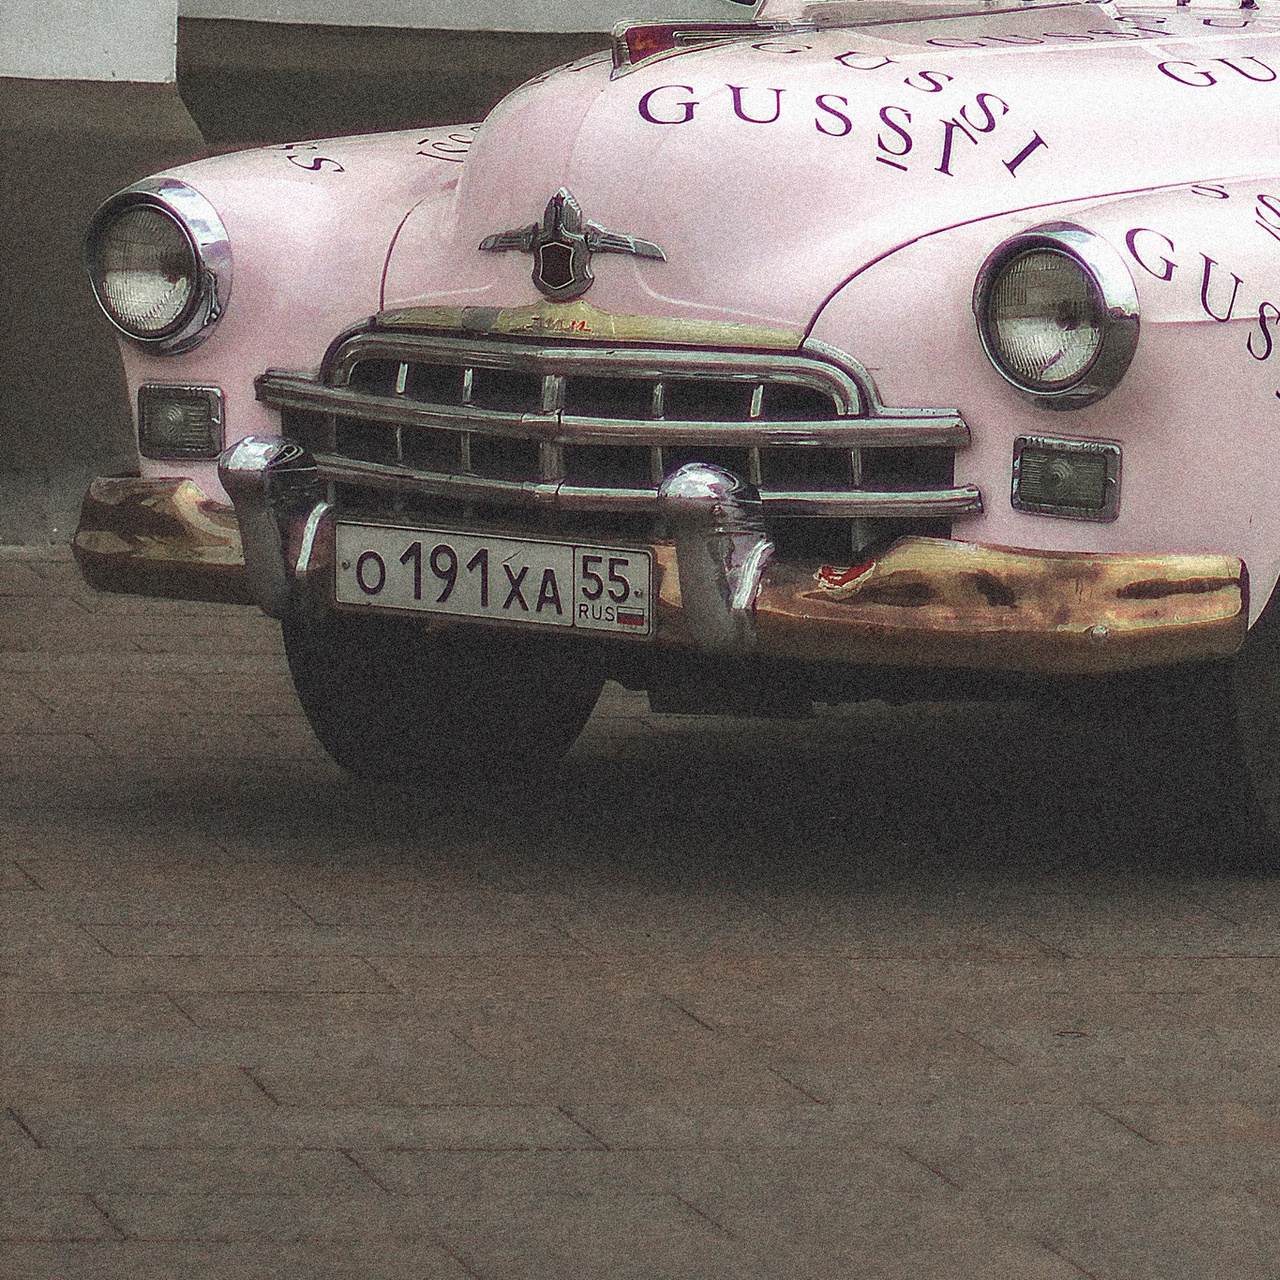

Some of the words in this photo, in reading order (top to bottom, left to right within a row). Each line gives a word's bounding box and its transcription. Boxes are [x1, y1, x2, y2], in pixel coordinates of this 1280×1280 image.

[637, 83, 966, 178] GUSSI
[750, 41, 1049, 178] GUSSI
[577, 603, 616, 623] RUS
[580, 554, 632, 604] 55
